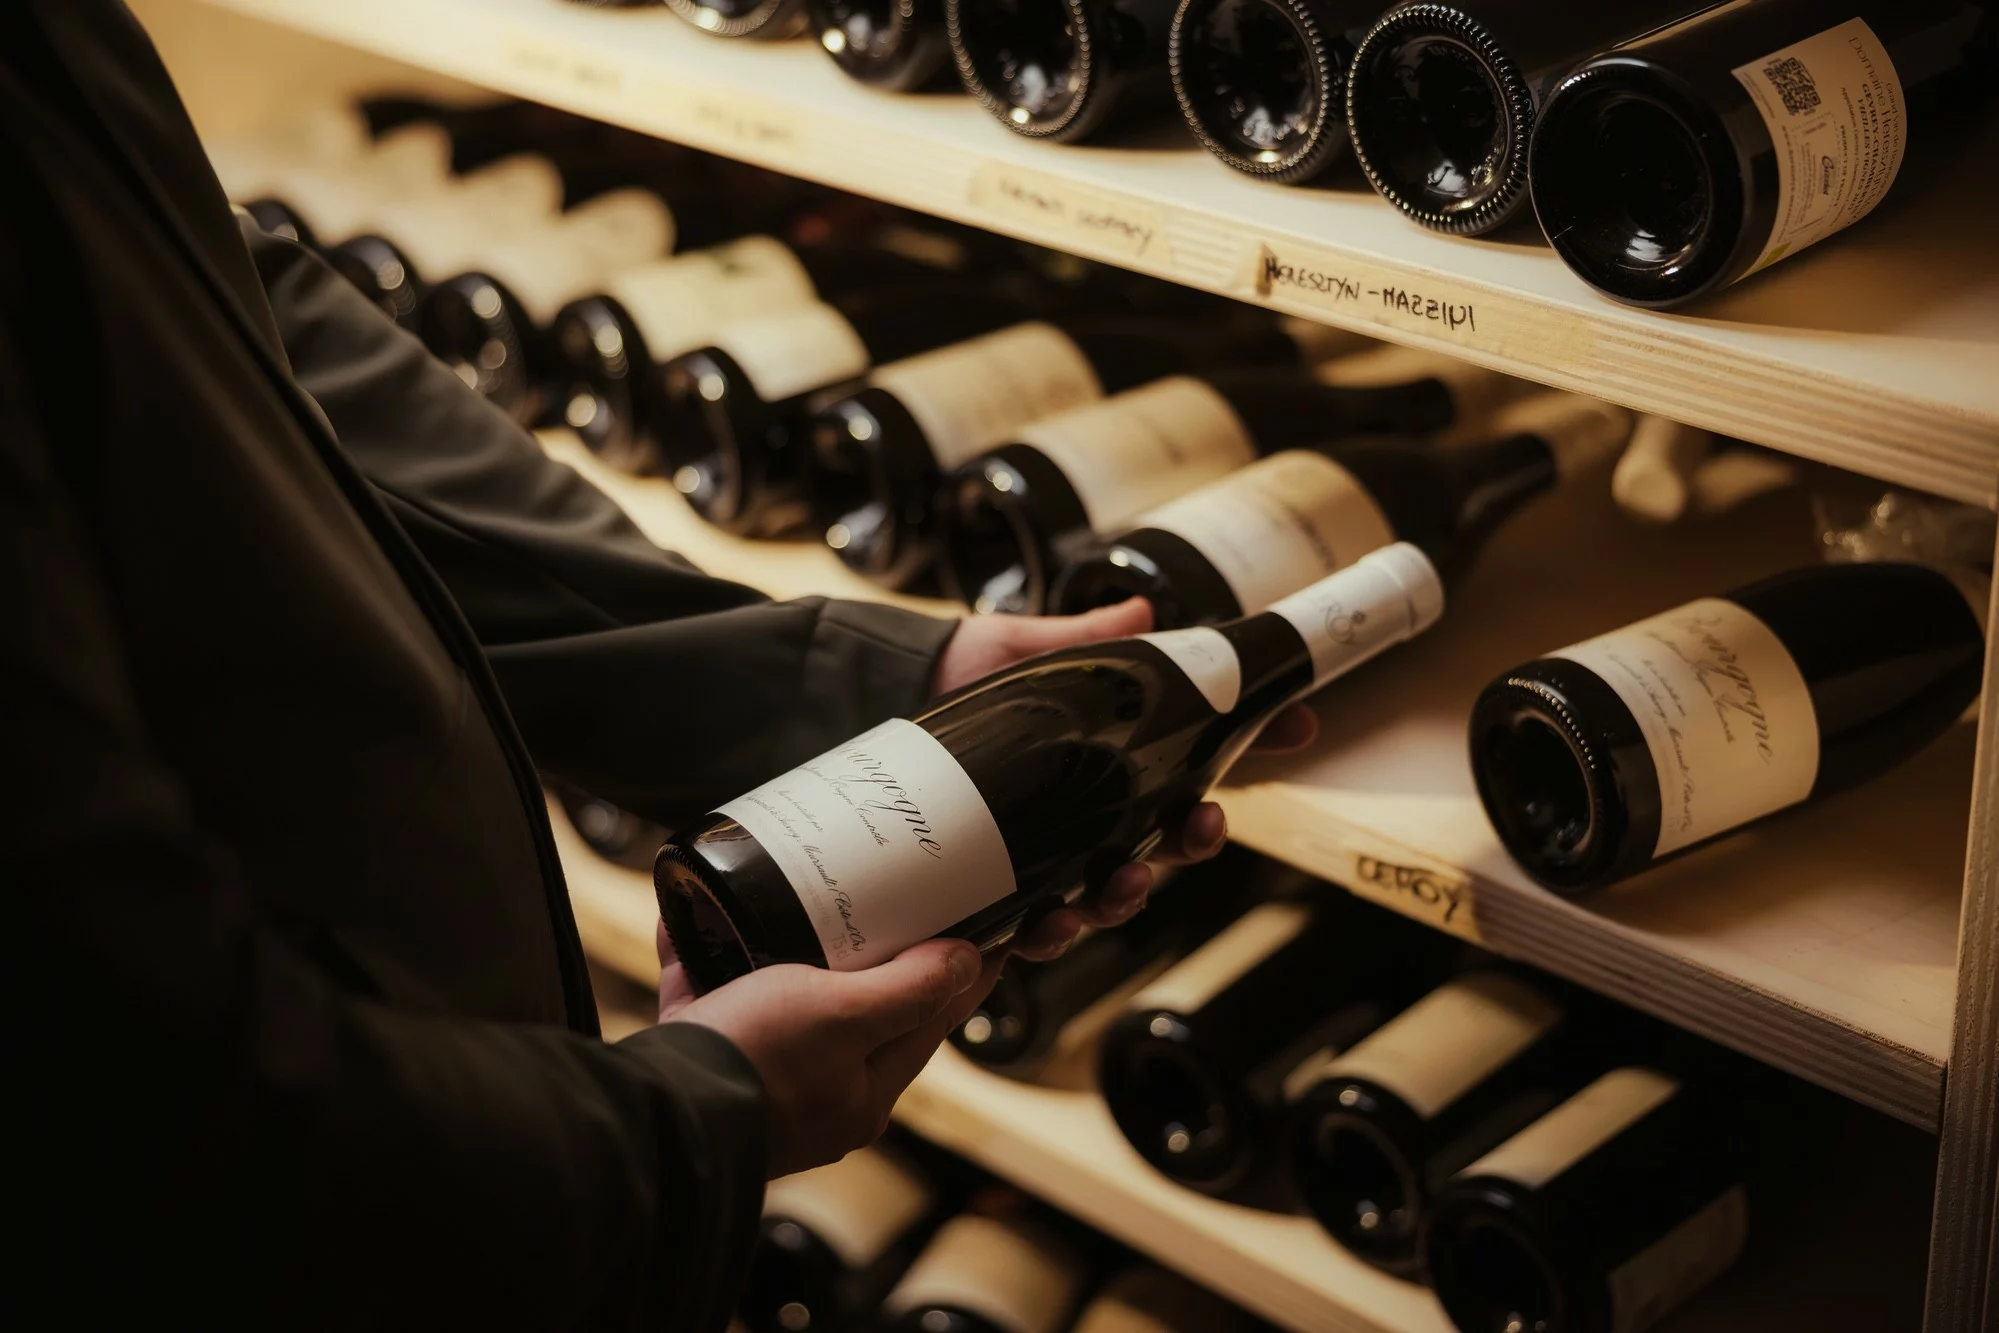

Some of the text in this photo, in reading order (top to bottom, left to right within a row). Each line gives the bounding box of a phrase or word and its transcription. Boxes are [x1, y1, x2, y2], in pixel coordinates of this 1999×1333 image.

[1847, 36, 1887, 107] Domaine
[1857, 98, 1870, 150] VIEILLES
[835, 734, 943, 859] ourgogne
